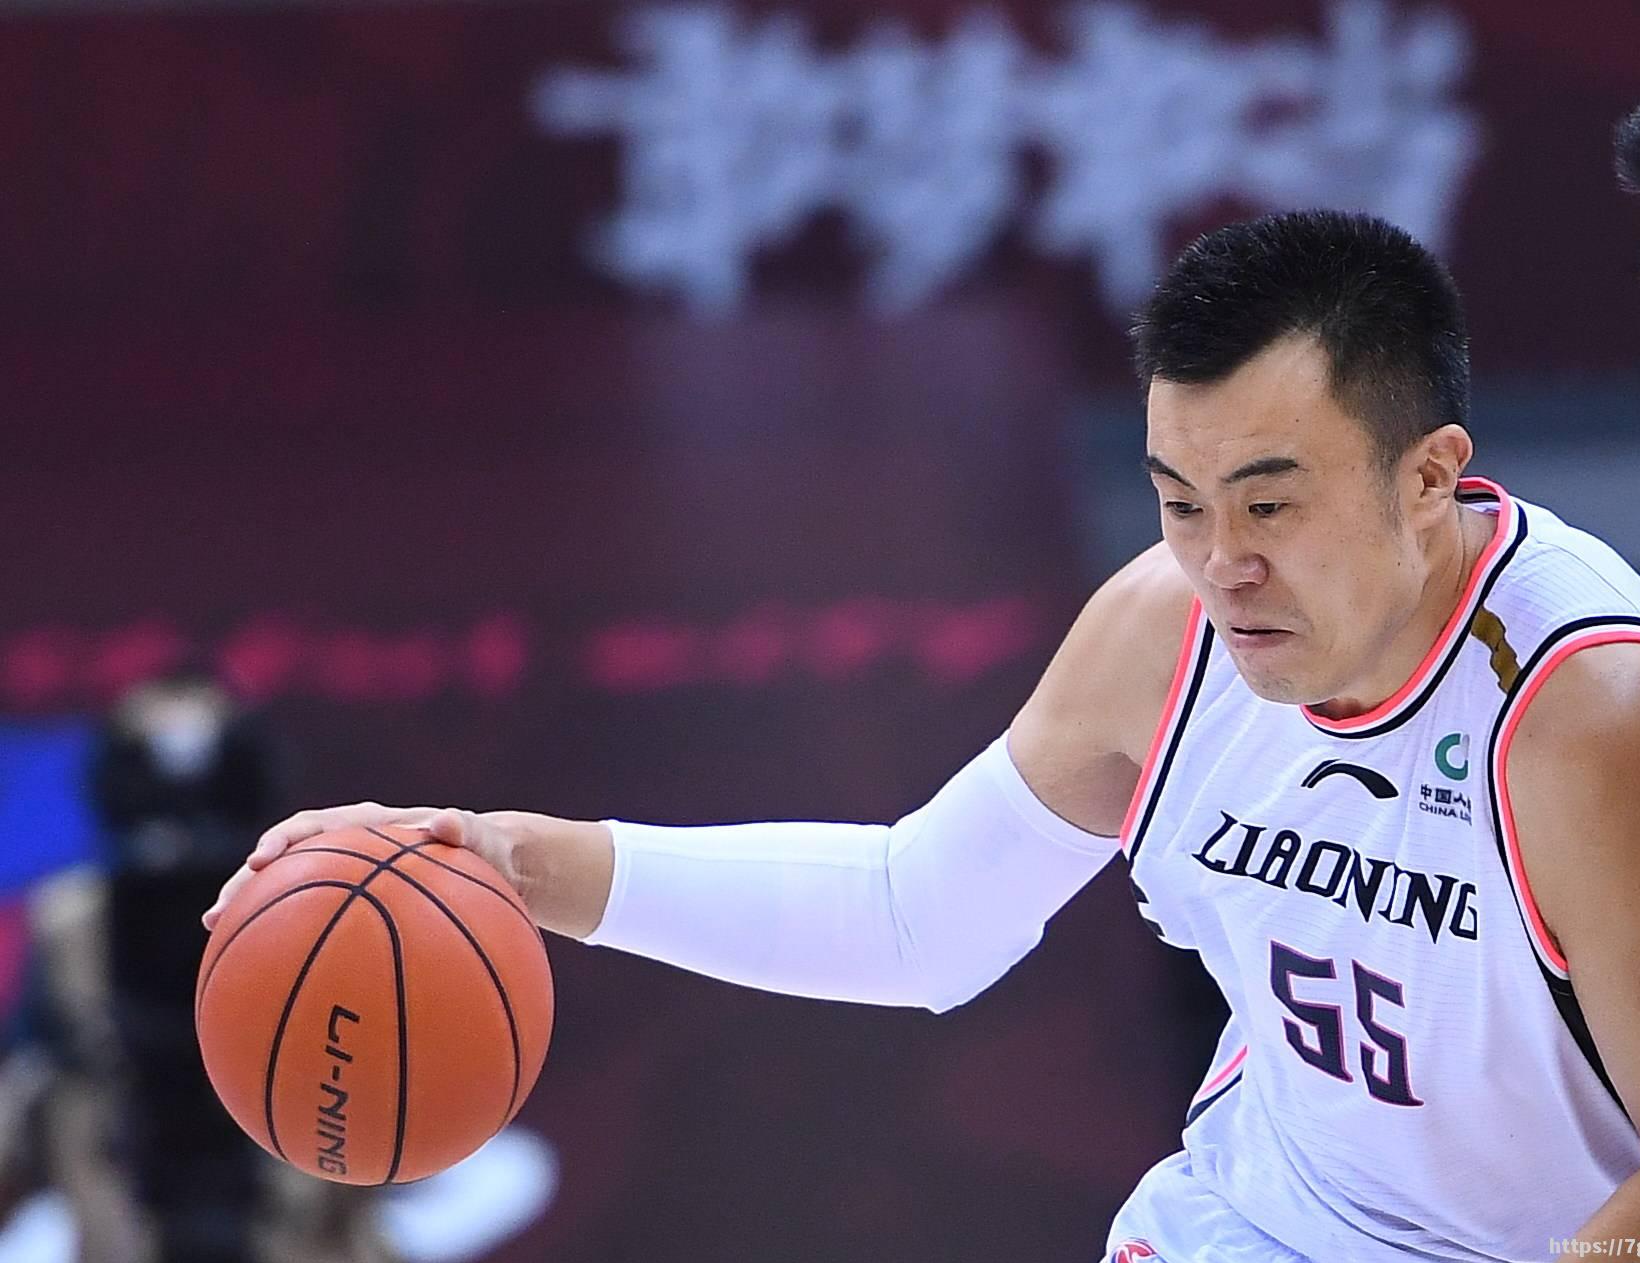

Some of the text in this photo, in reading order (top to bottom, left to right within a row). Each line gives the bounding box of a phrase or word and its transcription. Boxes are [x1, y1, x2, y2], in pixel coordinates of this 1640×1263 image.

[1191, 809, 1480, 944] LIAONING
[1419, 801, 1457, 818] CHINA
[317, 1003, 361, 1177] LI-NING
[1269, 939, 1425, 1108] 55
